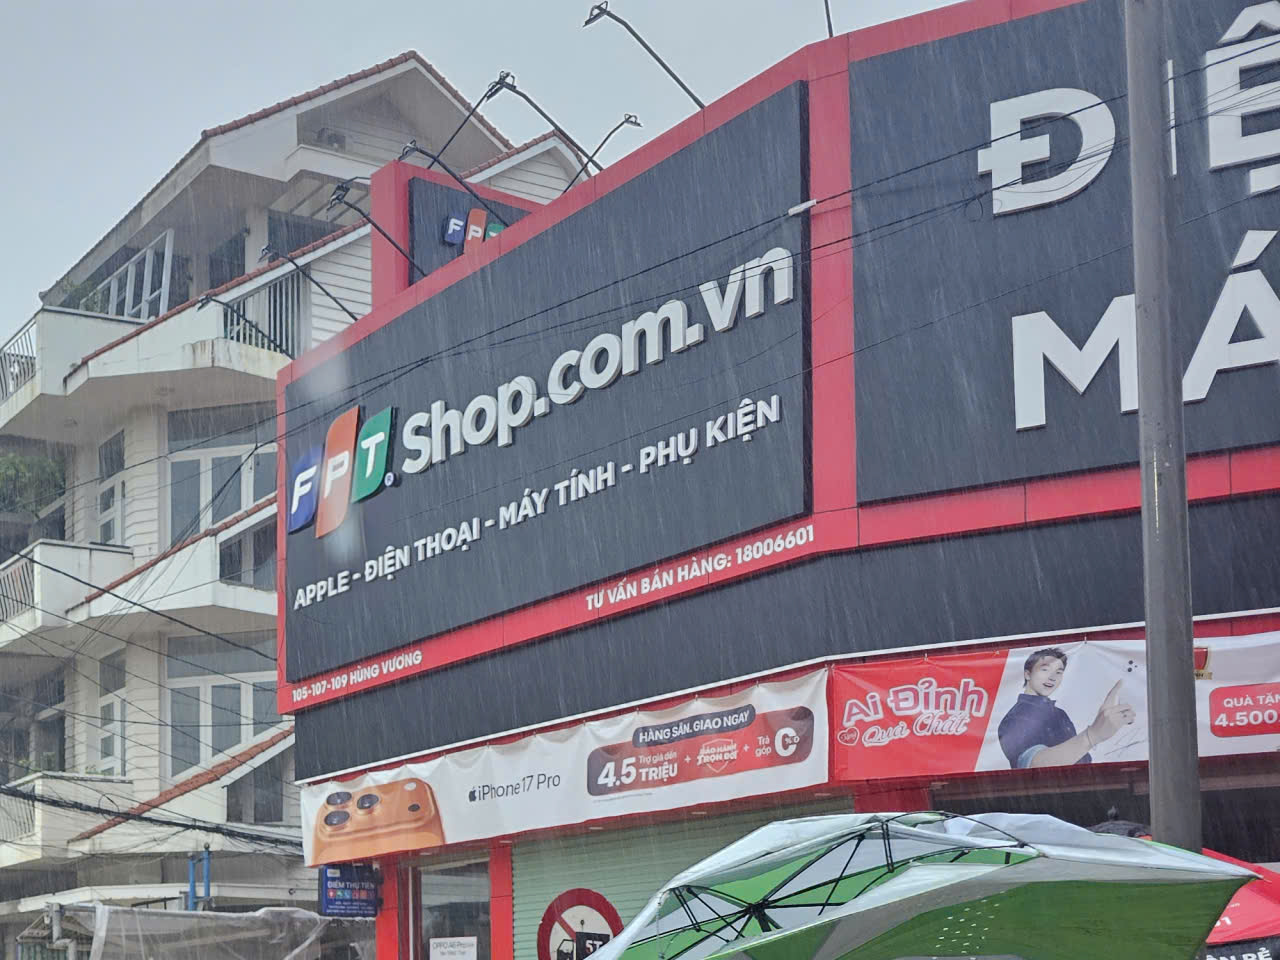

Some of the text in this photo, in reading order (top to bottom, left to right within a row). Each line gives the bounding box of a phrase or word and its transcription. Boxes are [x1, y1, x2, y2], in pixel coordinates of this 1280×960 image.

[977, 1, 1280, 216] ĐỆ
[290, 247, 794, 515] FPT Shop.com.vn
[293, 570, 350, 610] APPLE
[364, 545, 411, 582] ĐIỆN
[413, 516, 481, 561] THOẠI
[498, 487, 550, 530] MÁY
[554, 460, 616, 506] TÍNH
[639, 427, 698, 474] PHỤ
[706, 394, 780, 447] KIỆN
[586, 524, 815, 611] TƯ VẤN BÁN HÀNG: 18006601
[292, 649, 423, 703] 105-107-109 HÙNG VƯƠNG
[843, 677, 989, 727] Ai Đỉnh
[1223, 694, 1254, 708] QUÀ
[639, 728, 671, 743] HÀNG
[693, 717, 721, 732] GIAO
[723, 710, 750, 727] NGAY
[537, 773, 561, 792] Pro
[597, 757, 637, 788] 4.5
[639, 761, 678, 782] TRIỆU
[585, 940, 604, 953] 5T
